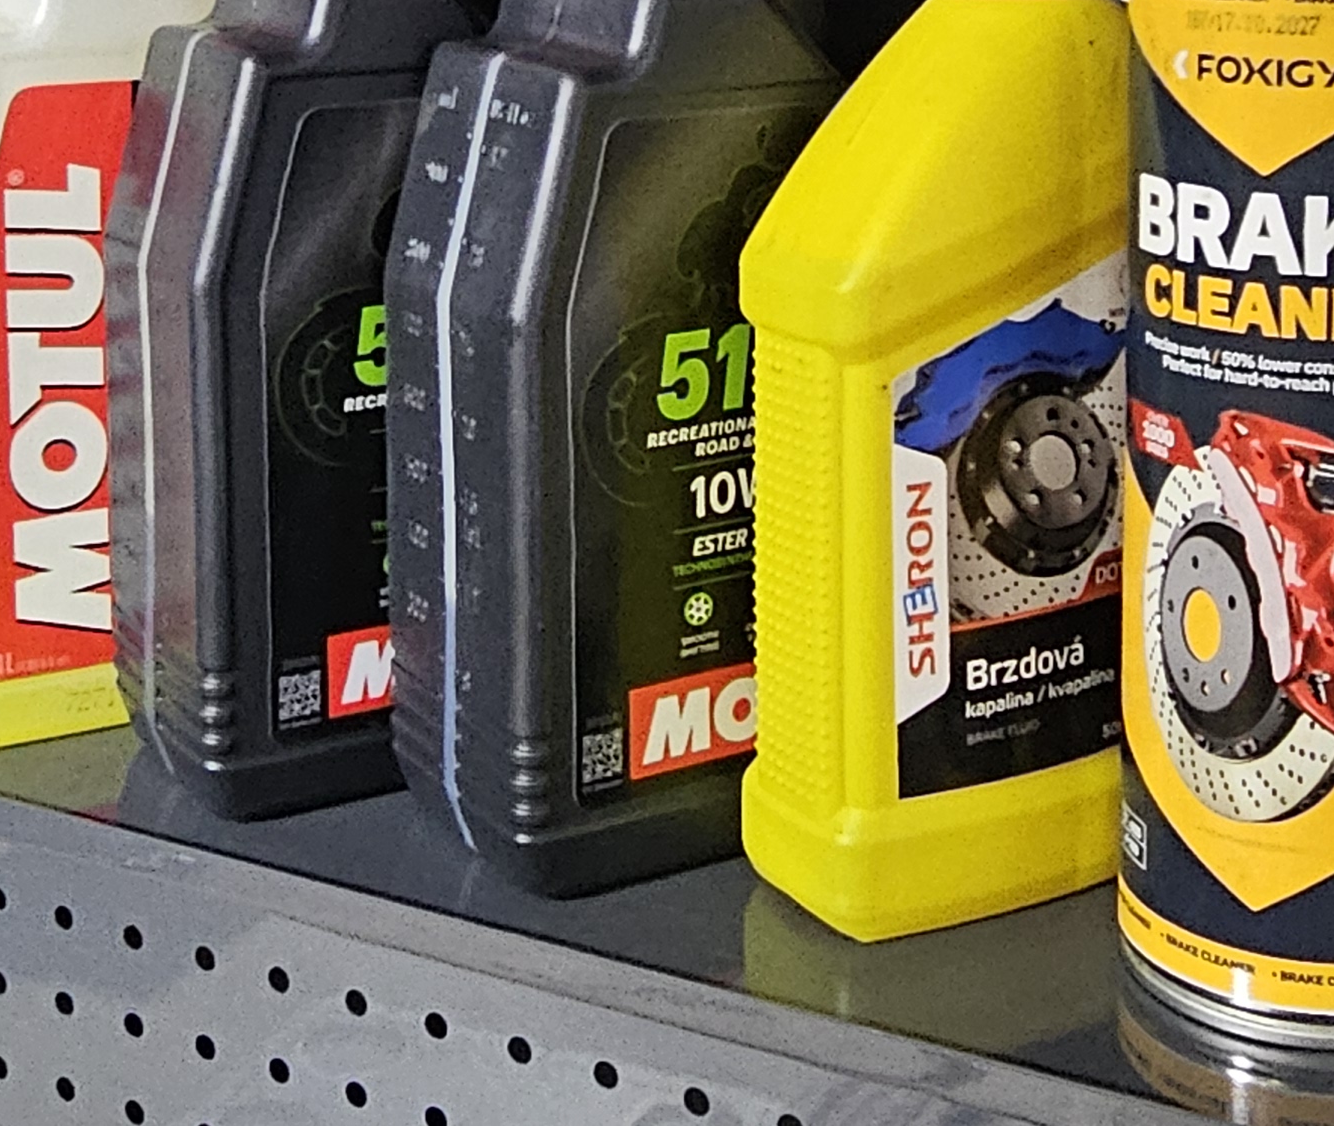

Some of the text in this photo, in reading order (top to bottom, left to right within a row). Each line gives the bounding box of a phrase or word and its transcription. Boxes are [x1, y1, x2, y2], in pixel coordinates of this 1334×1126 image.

[657, 324, 752, 421] 51
[1162, 354, 1202, 377] Perfect
[1224, 368, 1330, 392] hard-to-reach
[1221, 350, 1255, 370] 50%
[1258, 354, 1302, 373] lower
[3, 163, 114, 631] MOTUL
[647, 416, 755, 448] RECREATIONA
[695, 436, 739, 456] ROAD
[692, 529, 748, 556] ESTER
[904, 481, 938, 677] SHERON
[967, 634, 1085, 691] Brzdová
[965, 669, 1115, 718] kapalina kvapalina
[1166, 934, 1198, 957] BRAKE
[1280, 970, 1324, 986] BRAKE
